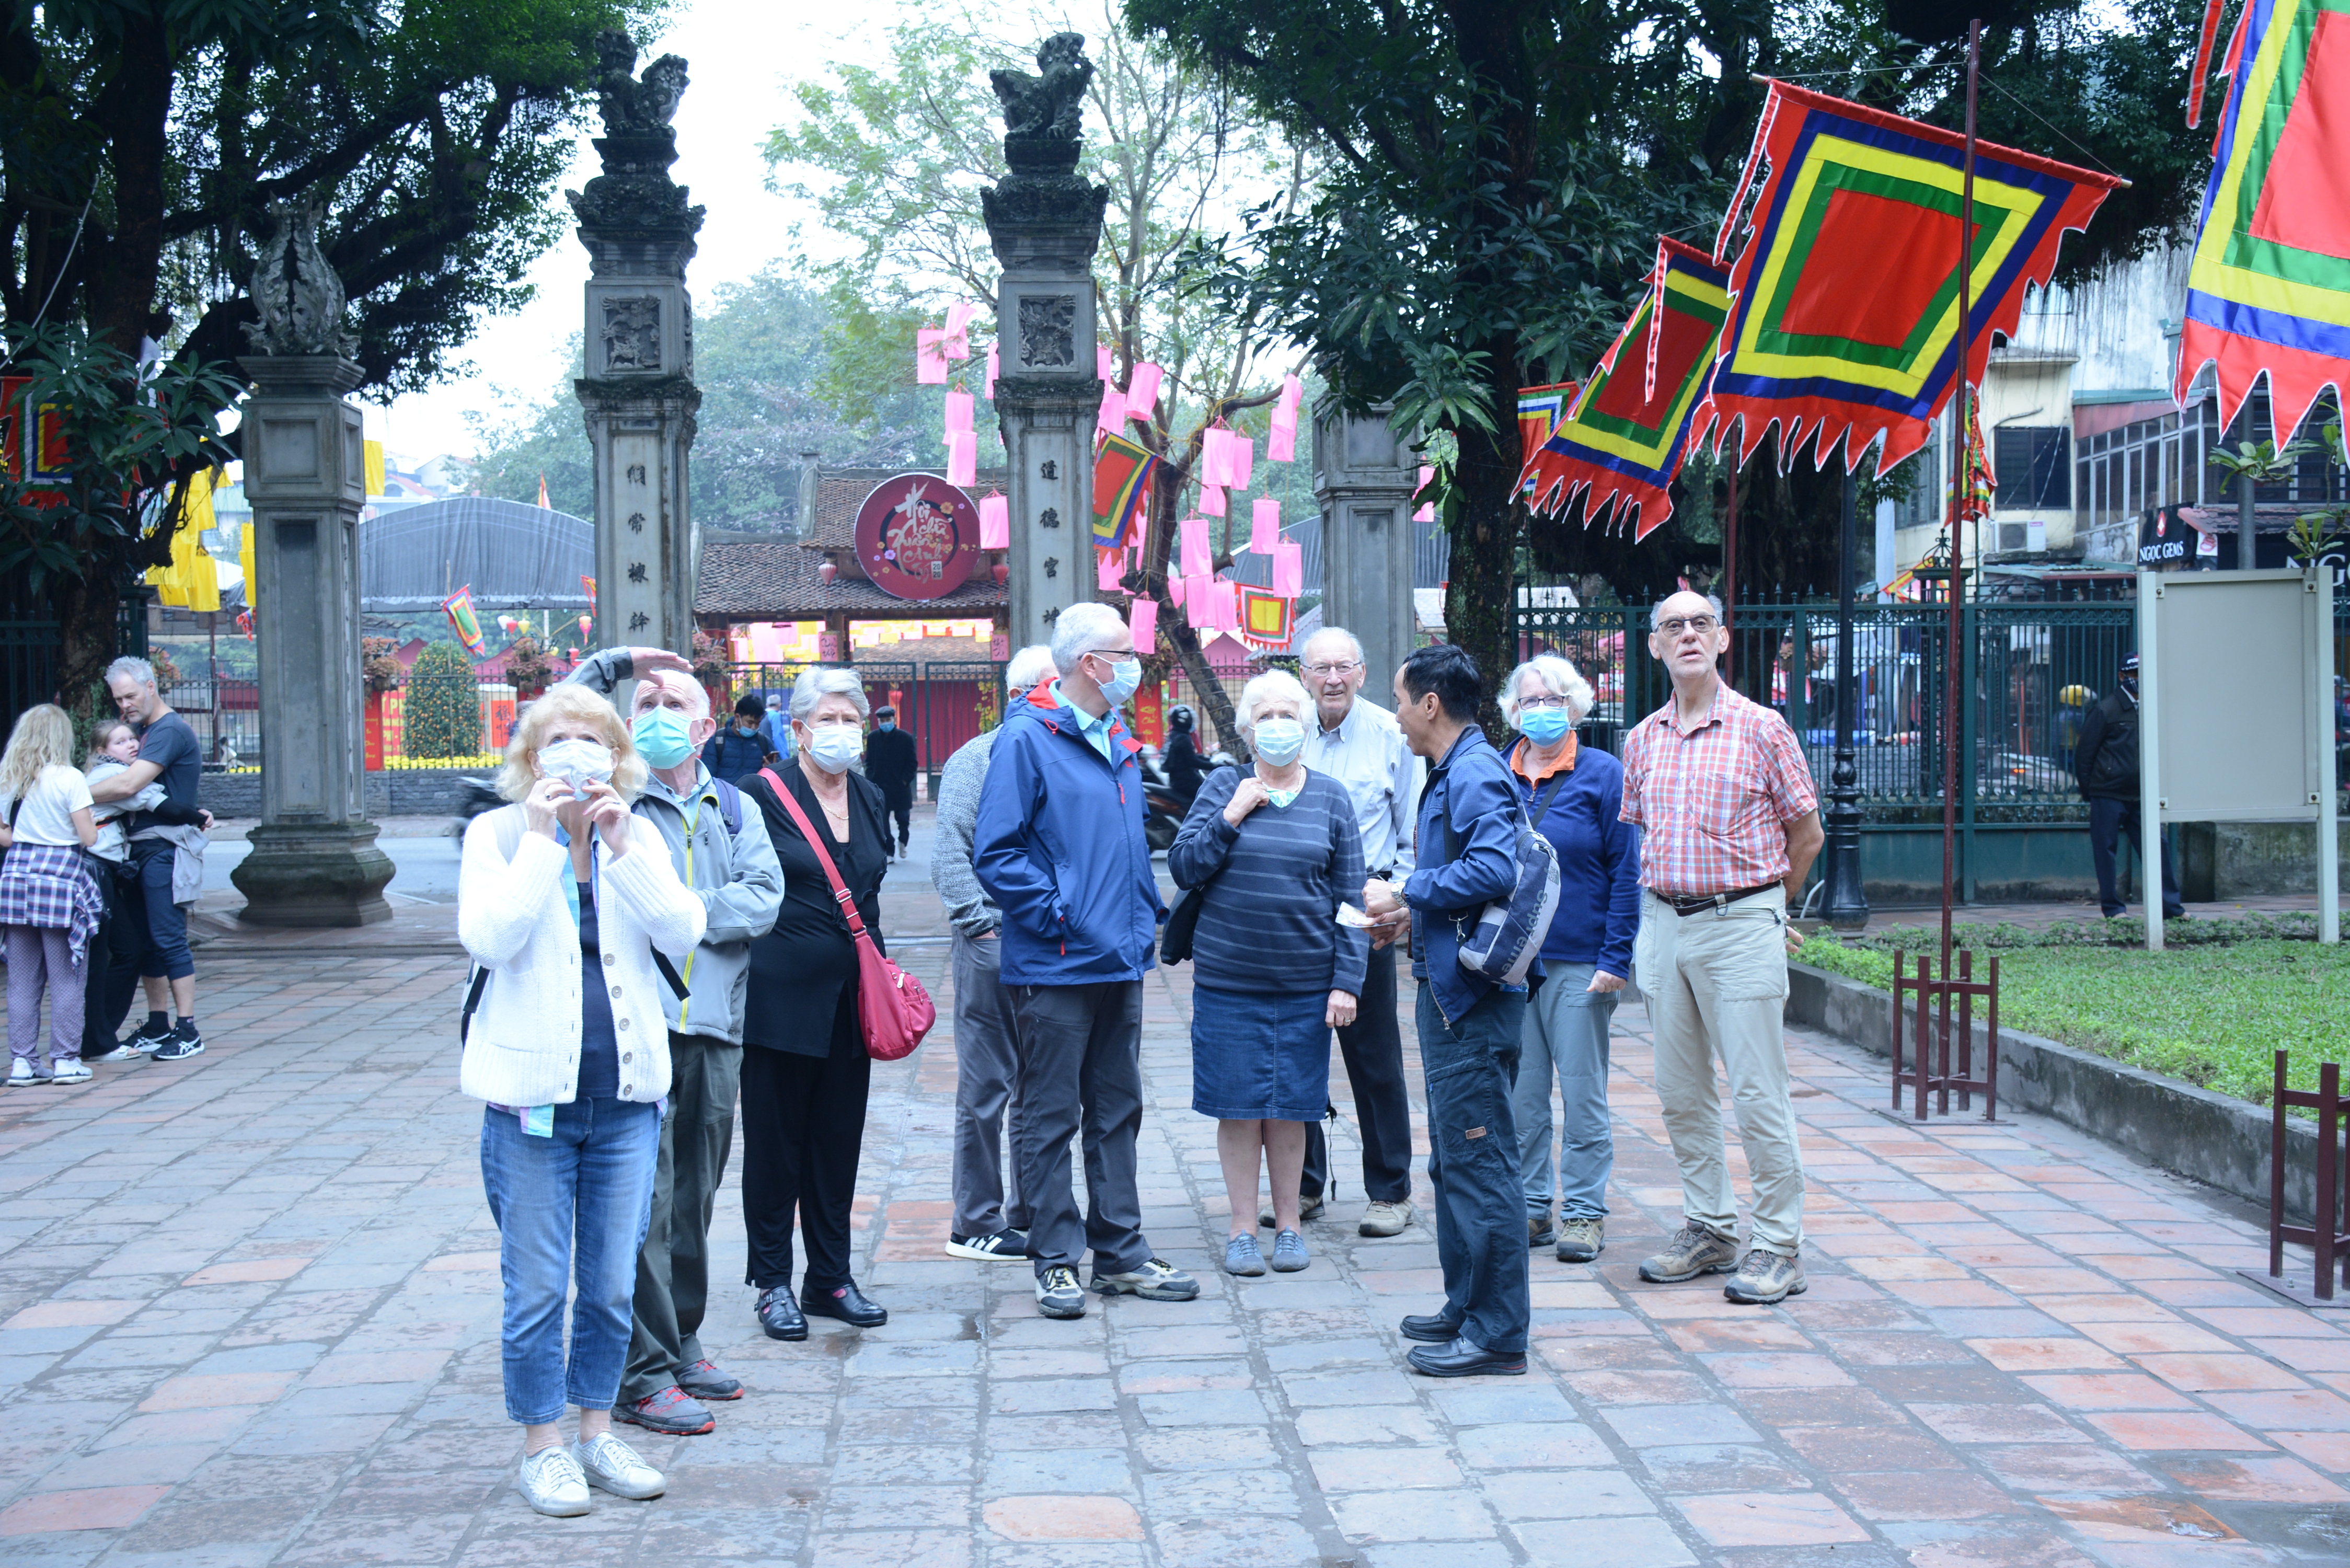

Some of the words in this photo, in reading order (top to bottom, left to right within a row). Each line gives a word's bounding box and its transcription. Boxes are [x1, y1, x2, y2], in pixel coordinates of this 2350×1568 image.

[2139, 544, 2161, 562] NGỌC
[2162, 540, 2184, 559] GEMS
[1502, 890, 1547, 973] Supreme
